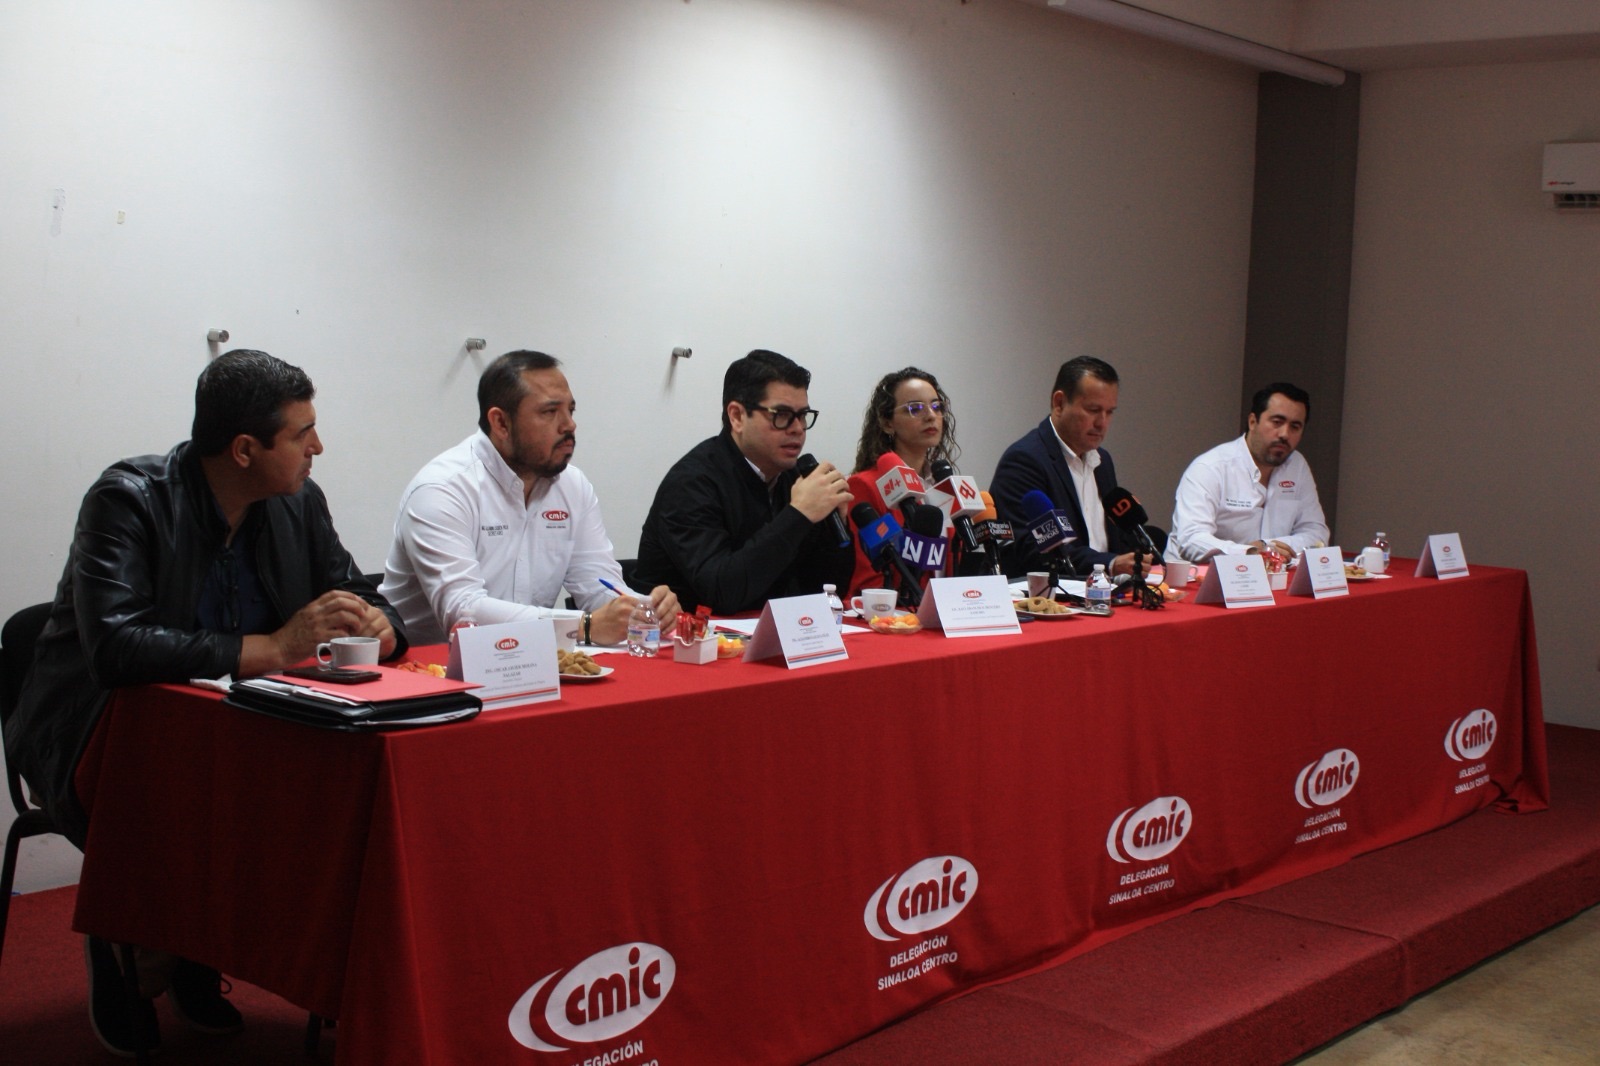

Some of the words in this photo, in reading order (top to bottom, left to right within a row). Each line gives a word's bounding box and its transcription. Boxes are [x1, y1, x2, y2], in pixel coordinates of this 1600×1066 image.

[548, 511, 566, 519] cmic
[1036, 525, 1059, 545] NOTICIAS
[1462, 711, 1493, 749] cmic
[1315, 751, 1354, 795] cmic
[1132, 799, 1185, 848] cmic
[1321, 822, 1347, 836] CENTRO
[898, 859, 967, 921] cmic
[1120, 864, 1169, 885] DELEGACIÓN
[1109, 886, 1142, 905] SINALOA
[1144, 879, 1175, 895] CENTRO
[890, 936, 948, 968] DELEGACIÓN
[565, 946, 661, 1026] cmic
[878, 965, 920, 991] SINALOA
[922, 952, 958, 974] CENTRO
[571, 1040, 644, 1066] EGACIÓN
